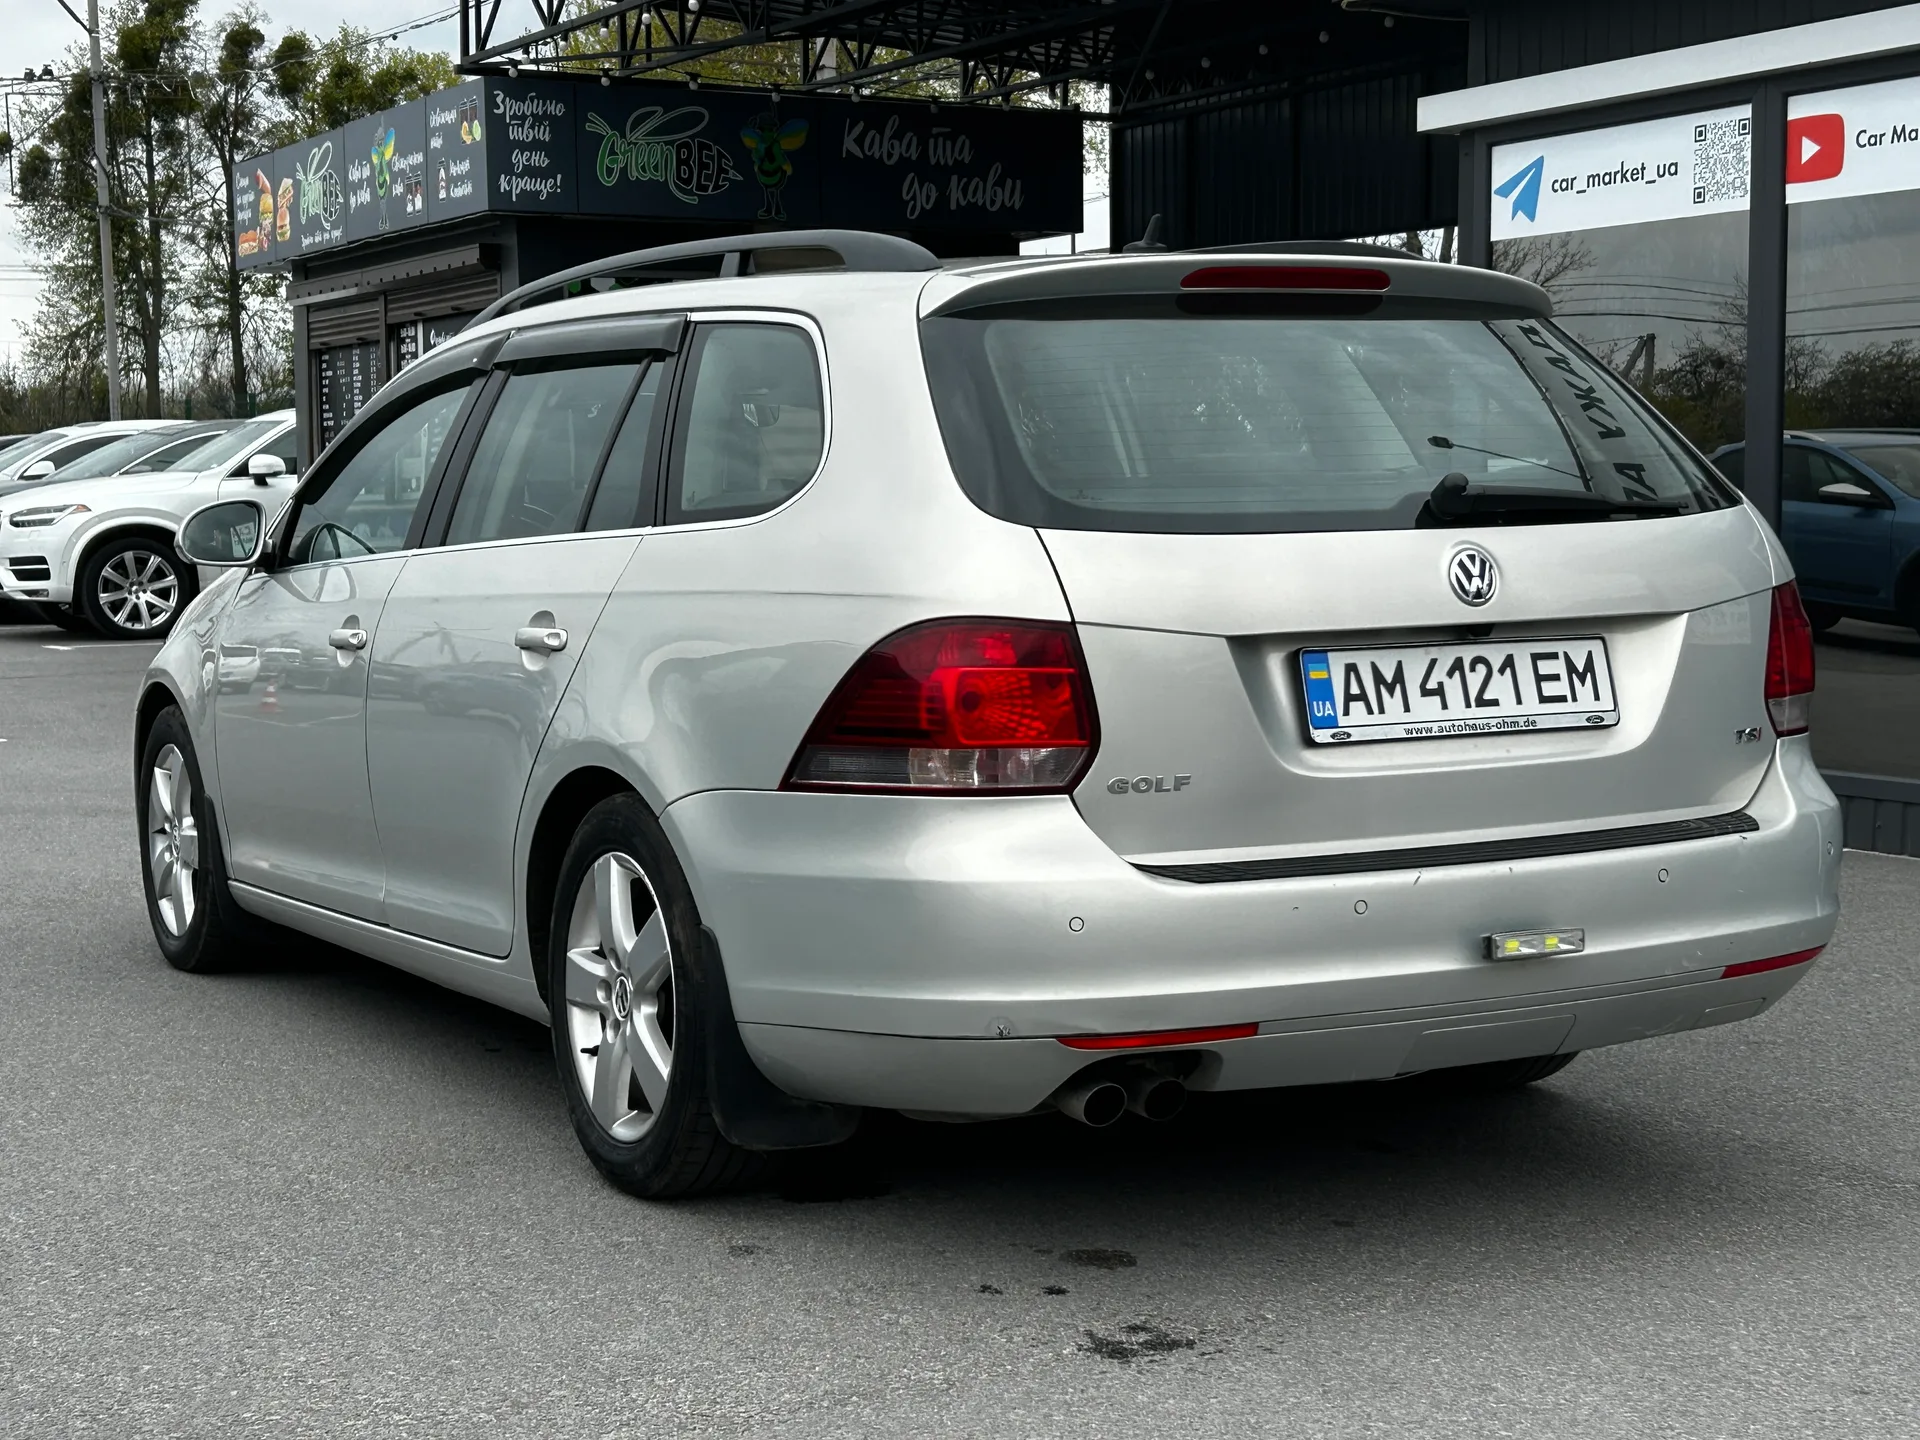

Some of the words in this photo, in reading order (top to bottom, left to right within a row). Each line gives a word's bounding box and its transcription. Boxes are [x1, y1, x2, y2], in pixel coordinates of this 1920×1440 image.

[493, 90, 566, 123] Зробимо
[508, 116, 552, 142] твій
[842, 114, 922, 166] Кава
[928, 126, 975, 166] та
[1855, 129, 1887, 149] Car
[511, 148, 550, 173] день
[498, 173, 562, 201] краще!
[1550, 160, 1679, 195] car_market_ua
[901, 172, 939, 220] до
[946, 162, 1025, 212] кави
[1342, 660, 1411, 717] AM
[1419, 654, 1523, 711] 4121
[1530, 649, 1601, 705] EM
[1313, 700, 1335, 718] UA
[1403, 717, 1539, 737] www.autohaus-ohm.de
[1734, 726, 1762, 745] TSI
[1106, 773, 1192, 795] GOLF
